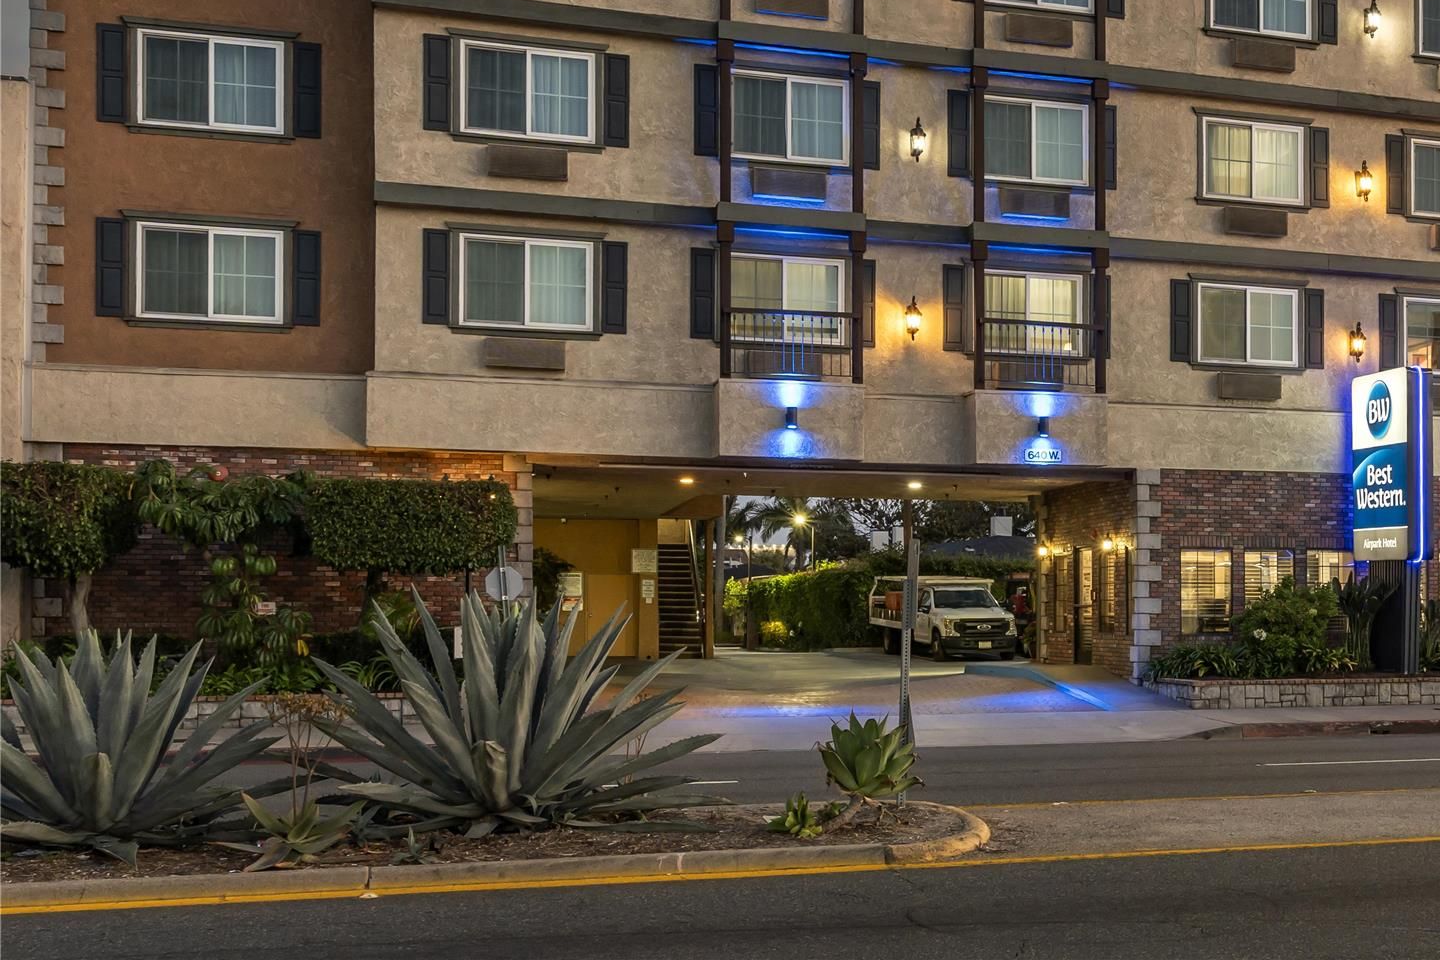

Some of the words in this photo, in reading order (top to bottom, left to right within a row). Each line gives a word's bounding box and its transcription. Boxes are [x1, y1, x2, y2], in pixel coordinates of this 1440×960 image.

[1369, 397, 1390, 424] BW
[1027, 450, 1048, 459] 640
[1048, 451, 1060, 460] W.
[1367, 464, 1393, 486] Best
[1363, 538, 1382, 550] Airpark
[1382, 536, 1397, 548] Hotel
